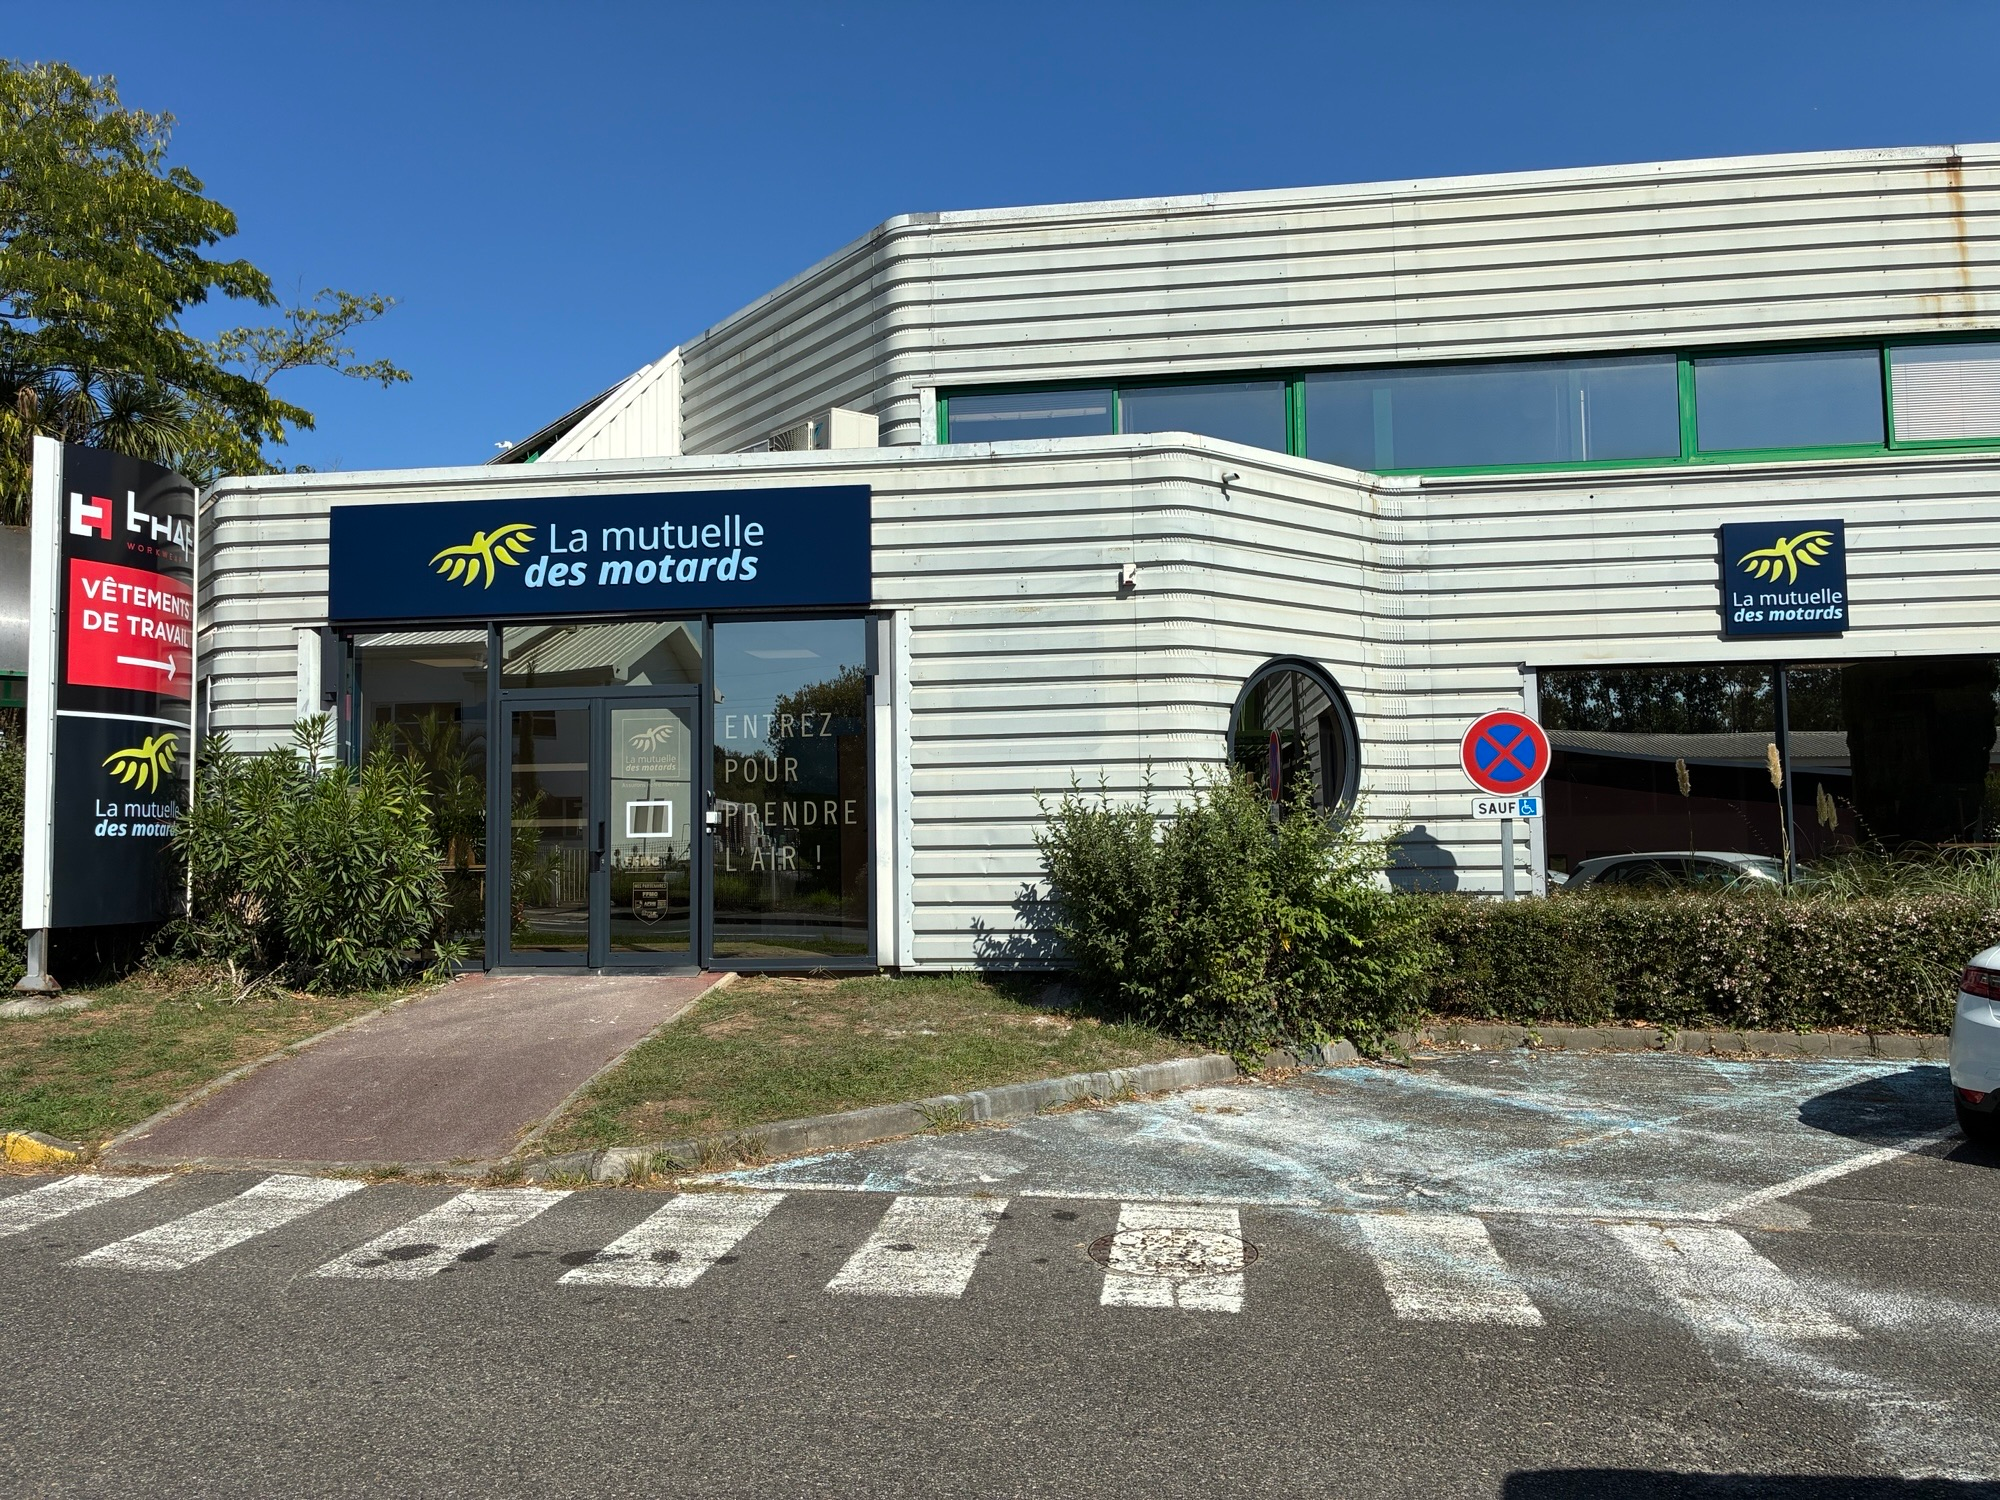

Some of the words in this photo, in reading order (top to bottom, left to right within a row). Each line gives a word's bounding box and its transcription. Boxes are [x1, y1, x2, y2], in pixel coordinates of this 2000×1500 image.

[550, 523, 588, 553] La
[602, 514, 764, 551] mutuelle
[524, 556, 588, 588] des
[598, 549, 759, 585] motards
[81, 576, 190, 620] VÊTEMENTS
[1733, 592, 1754, 607] La
[1760, 588, 1843, 605] mutuelle
[1733, 608, 1764, 622] des
[1769, 605, 1843, 621] motards
[83, 609, 119, 633] DE
[126, 615, 189, 648] TRAVAIL
[725, 712, 832, 739] ENTREZ
[625, 763, 640, 772] des
[641, 762, 677, 771] motards
[626, 755, 636, 764] La
[638, 754, 677, 763] mutuelle
[725, 757, 798, 783] POUR
[95, 799, 118, 817] La
[125, 800, 180, 819] mutuelle
[725, 800, 857, 828] PRENDRE
[1478, 802, 1516, 815] SAUF
[95, 819, 127, 837] des
[131, 821, 178, 837] motar
